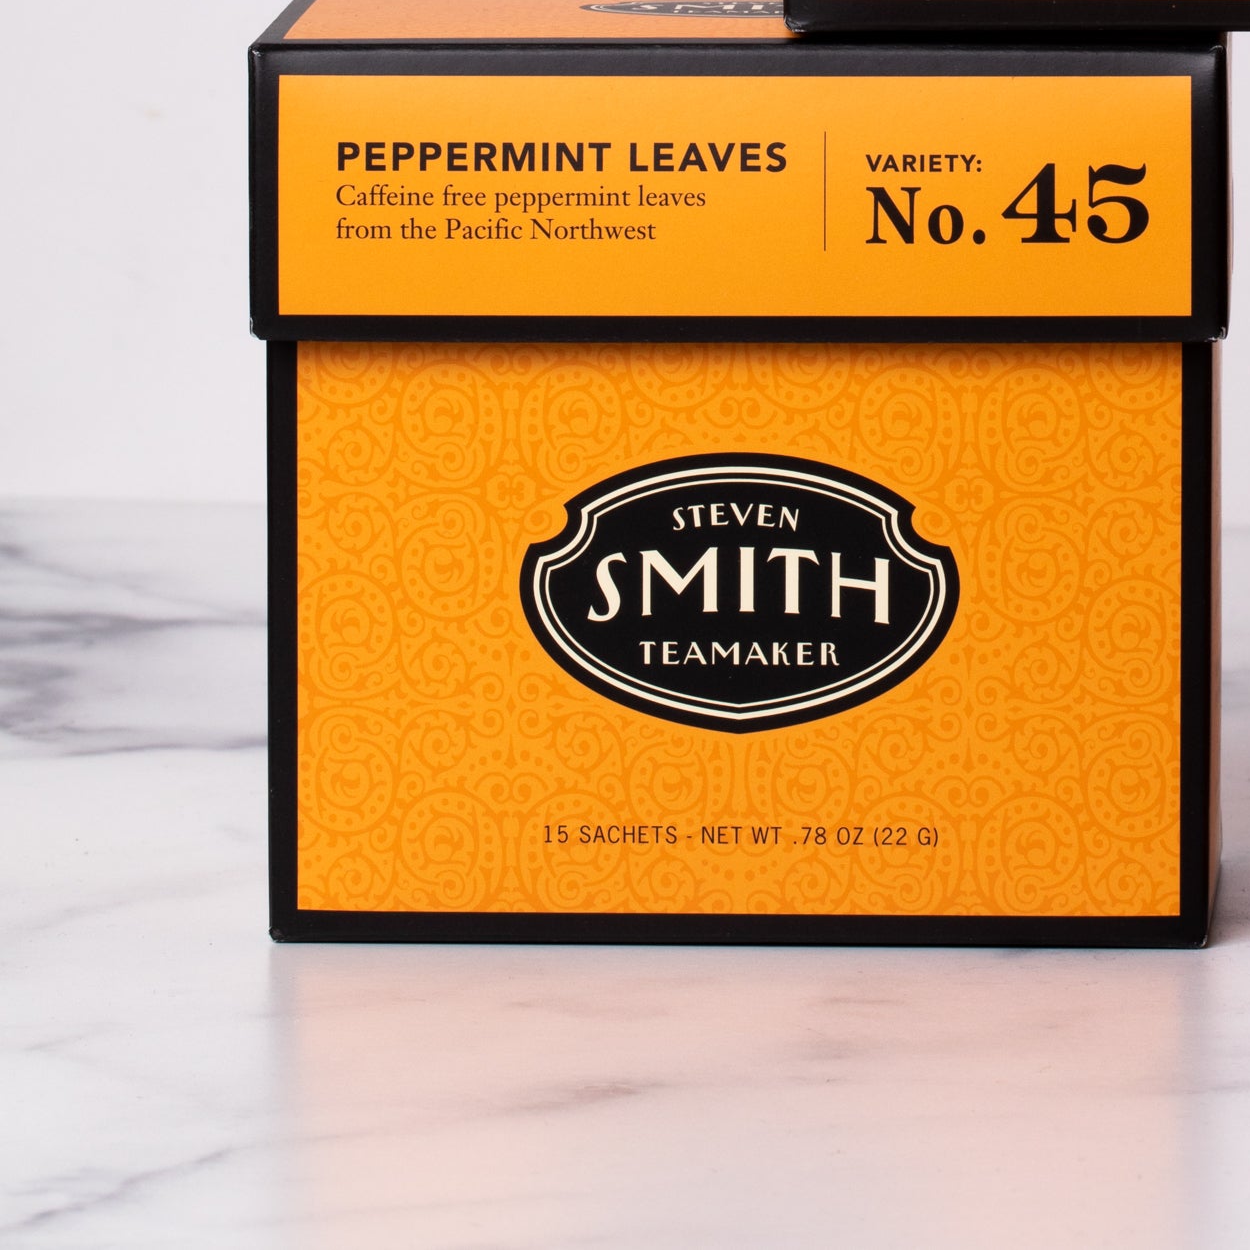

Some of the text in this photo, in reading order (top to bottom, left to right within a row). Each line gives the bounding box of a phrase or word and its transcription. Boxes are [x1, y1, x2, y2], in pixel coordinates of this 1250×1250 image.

[337, 141, 787, 173] PEPPERMINT LEAVES
[865, 154, 982, 173] VARIETY:
[335, 183, 706, 214] Caffeine free peppermint leaves
[336, 217, 657, 240] from the Pacific Northwest
[672, 502, 799, 532] STEVEN
[586, 546, 891, 625] SMITH
[638, 641, 840, 666] TEAMAKER
[544, 824, 569, 844] 15
[579, 824, 678, 845] SACHETS
[701, 825, 743, 845] NET
[751, 826, 783, 845] WT
[793, 826, 827, 846] .78
[836, 826, 864, 846] OZ
[873, 826, 908, 847] (22
[917, 826, 939, 848] G)
